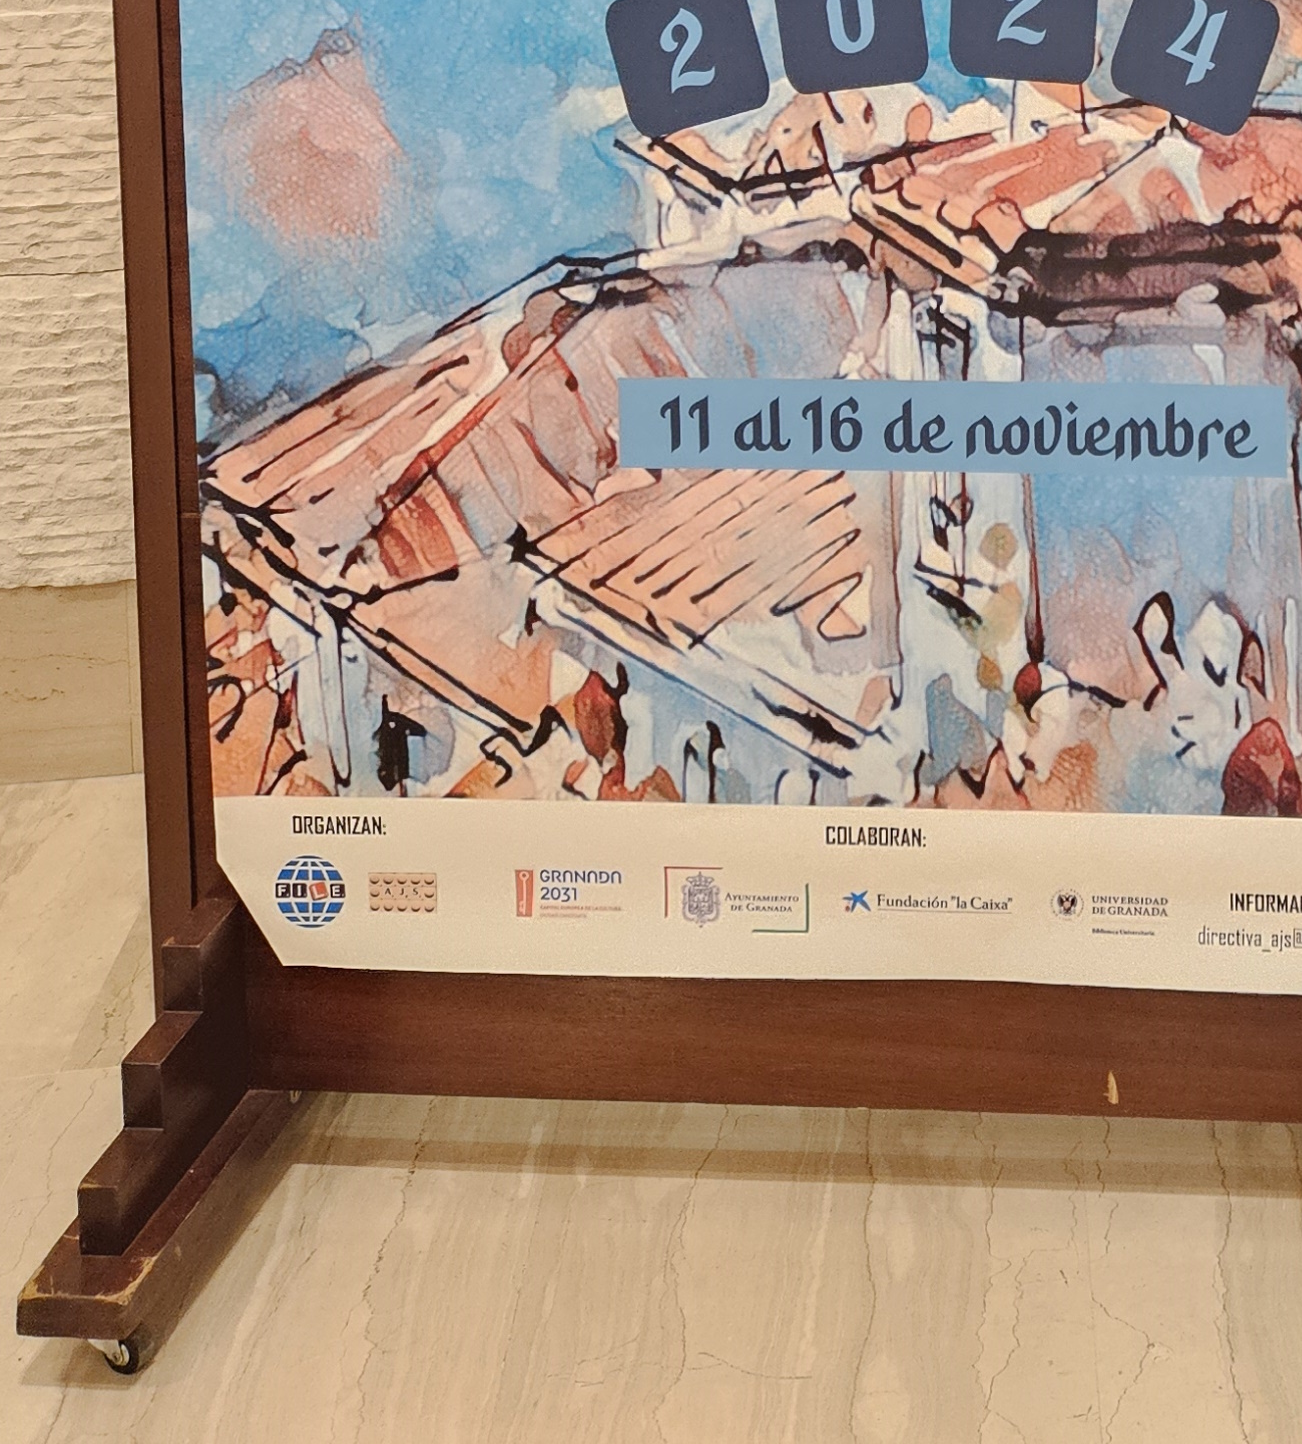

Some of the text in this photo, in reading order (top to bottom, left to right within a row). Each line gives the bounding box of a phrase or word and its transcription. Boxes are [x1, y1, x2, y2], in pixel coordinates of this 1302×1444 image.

[660, 395, 1259, 462] 11 al 16 de noviembre
[292, 814, 387, 836] ORGANIZAN:
[826, 825, 927, 848] COLABORAN:
[540, 869, 622, 884] GRANADA
[540, 887, 577, 902] 2031
[877, 893, 948, 909] Fundación
[1092, 895, 1169, 906] UNIVERSIDAD
[1092, 906, 1169, 917] DE GRANADA
